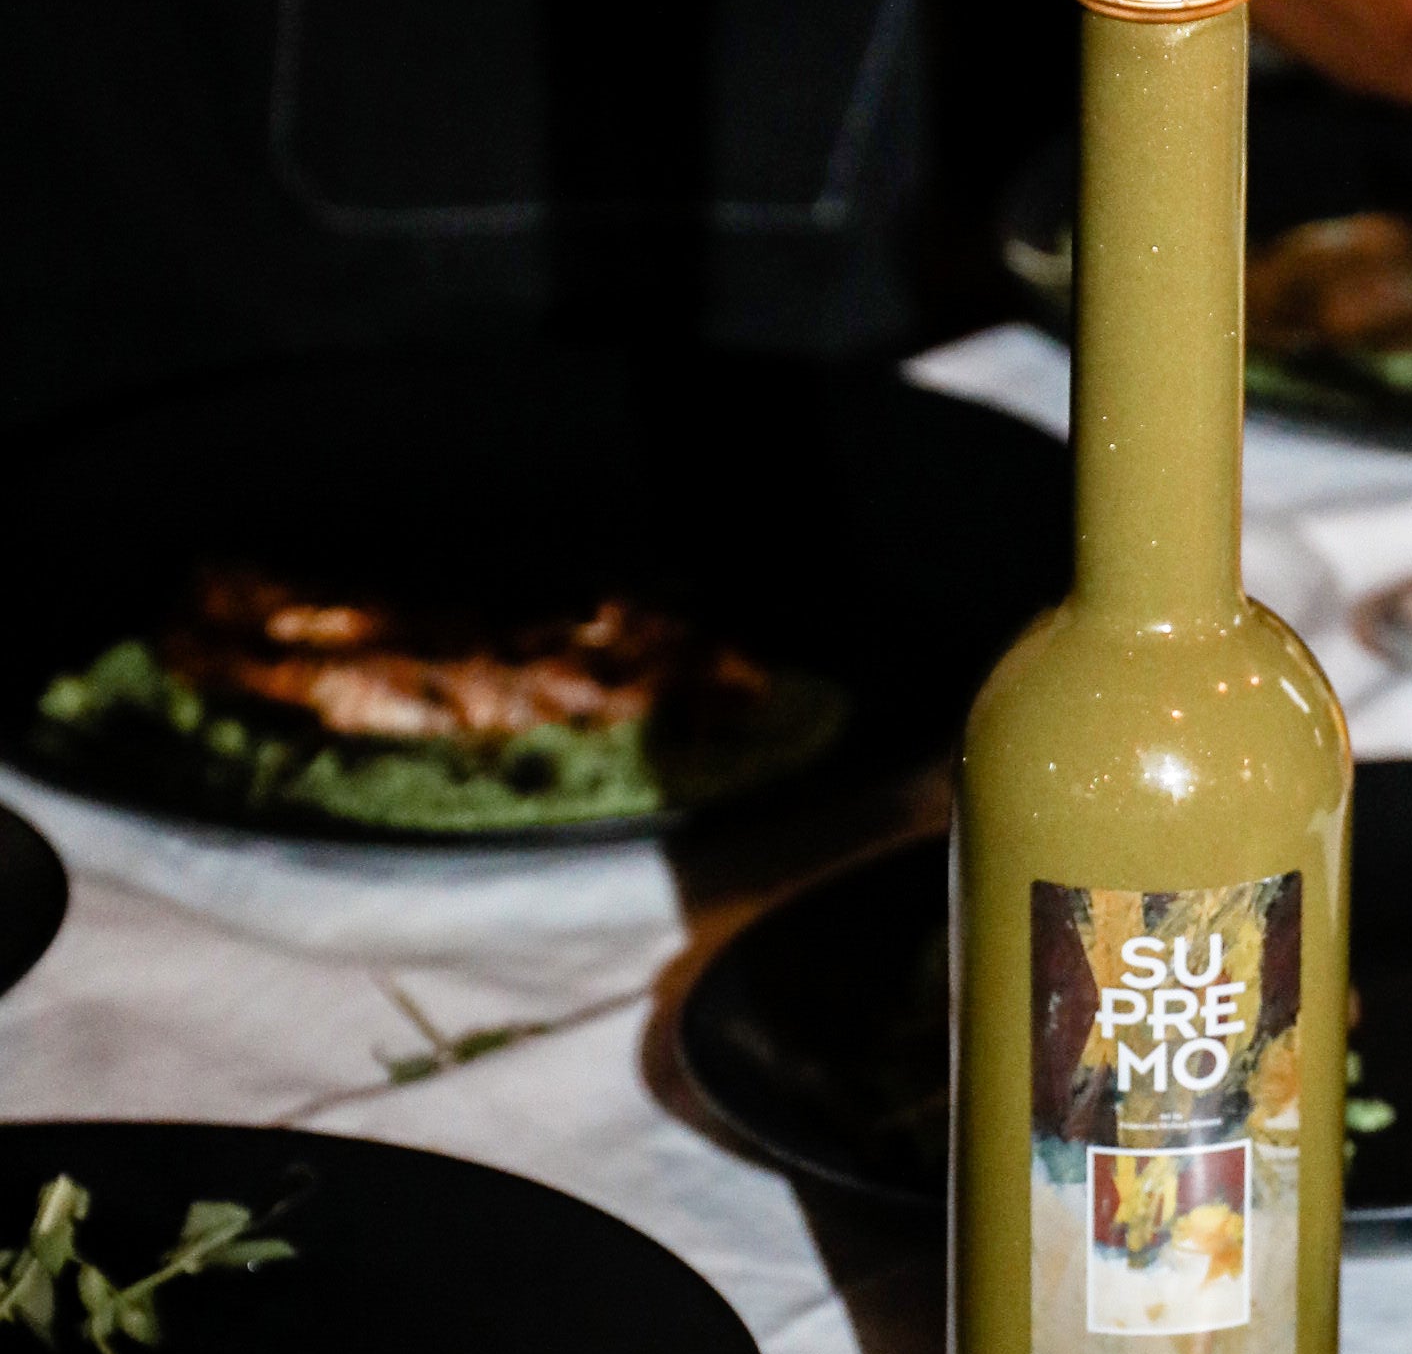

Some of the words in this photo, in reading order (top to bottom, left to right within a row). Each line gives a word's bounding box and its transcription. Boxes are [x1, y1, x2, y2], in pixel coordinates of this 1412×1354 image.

[1120, 932, 1224, 990] SU
[1095, 981, 1247, 1040] PRE
[1116, 1037, 1231, 1093] MO
